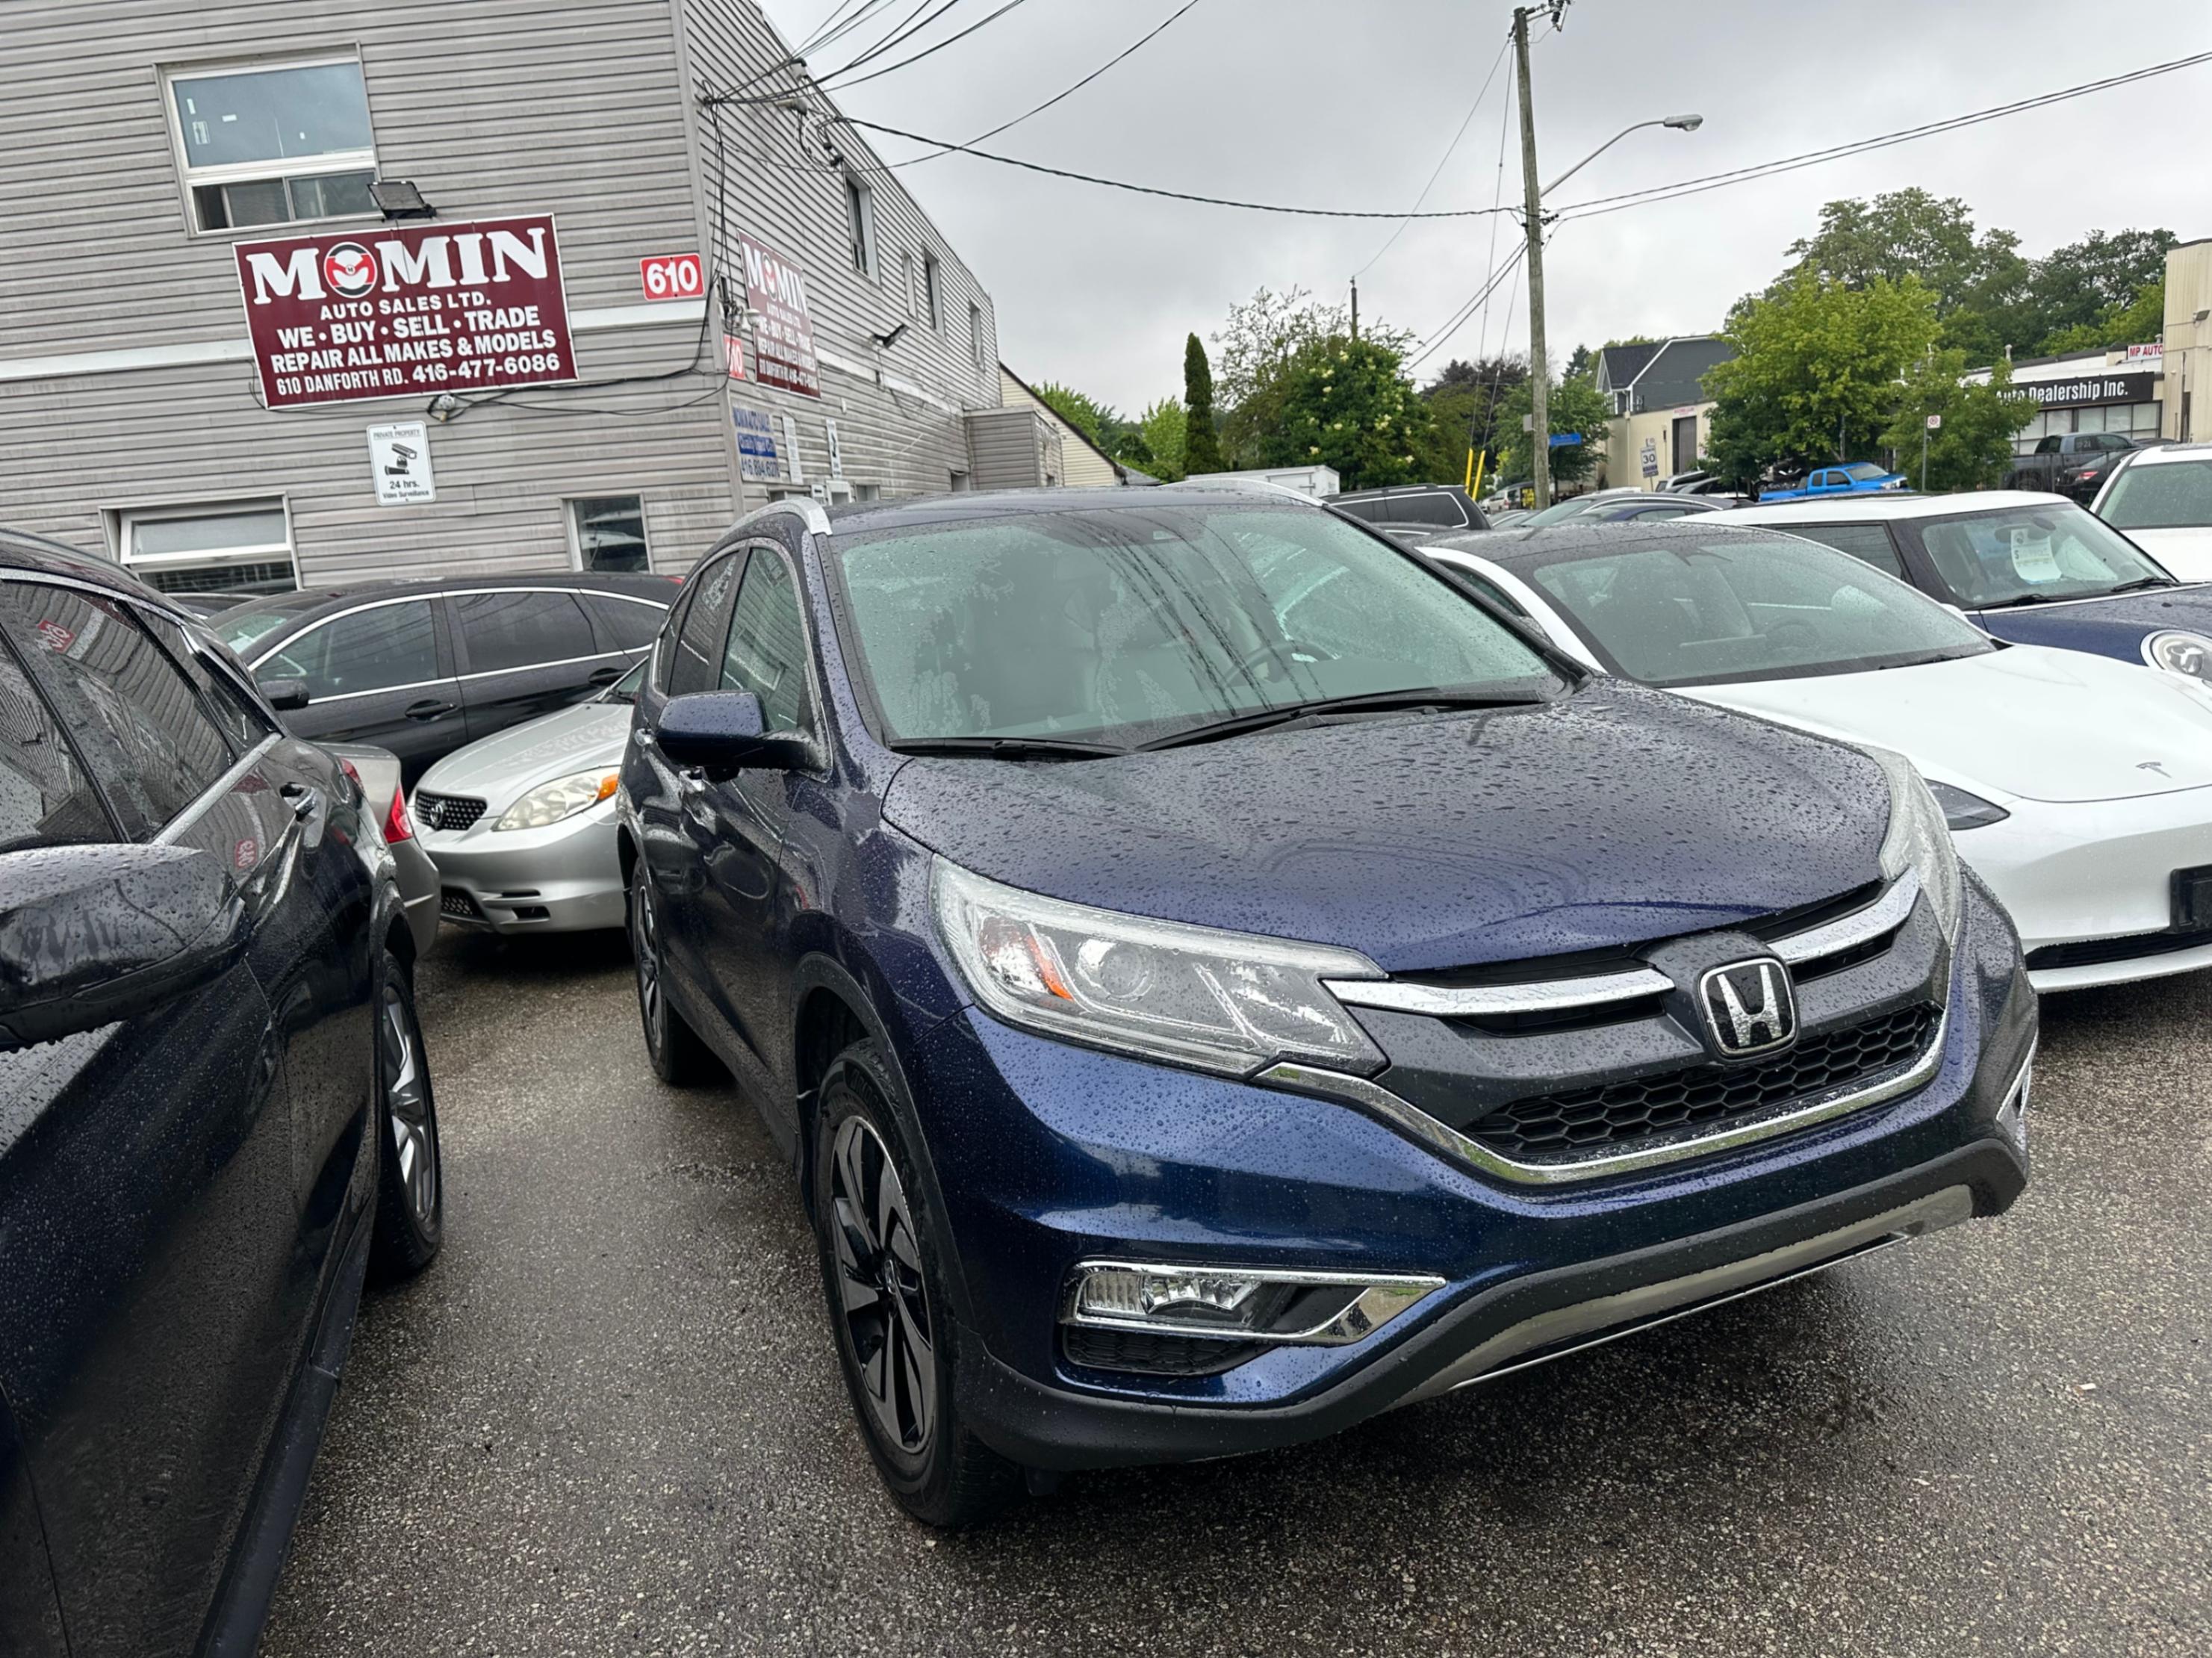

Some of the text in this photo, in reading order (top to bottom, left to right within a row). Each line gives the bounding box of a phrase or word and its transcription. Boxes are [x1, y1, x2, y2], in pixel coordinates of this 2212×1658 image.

[246, 227, 548, 304] MOMIN
[646, 260, 698, 294] 610
[320, 291, 491, 320] AUTO SALES LTD.
[277, 305, 541, 349] WE BUY SELL TRADE
[270, 329, 556, 373] REPAIR ALL MAKES & MODELS
[2130, 347, 2141, 357] MP
[276, 353, 560, 396] 610 DANFORTH RD. 416-477-6086
[2028, 381, 2101, 403] Dealership
[2104, 379, 2128, 397] Inc.
[1643, 453, 1656, 464] 30
[389, 479, 420, 489] 24 hrs.
